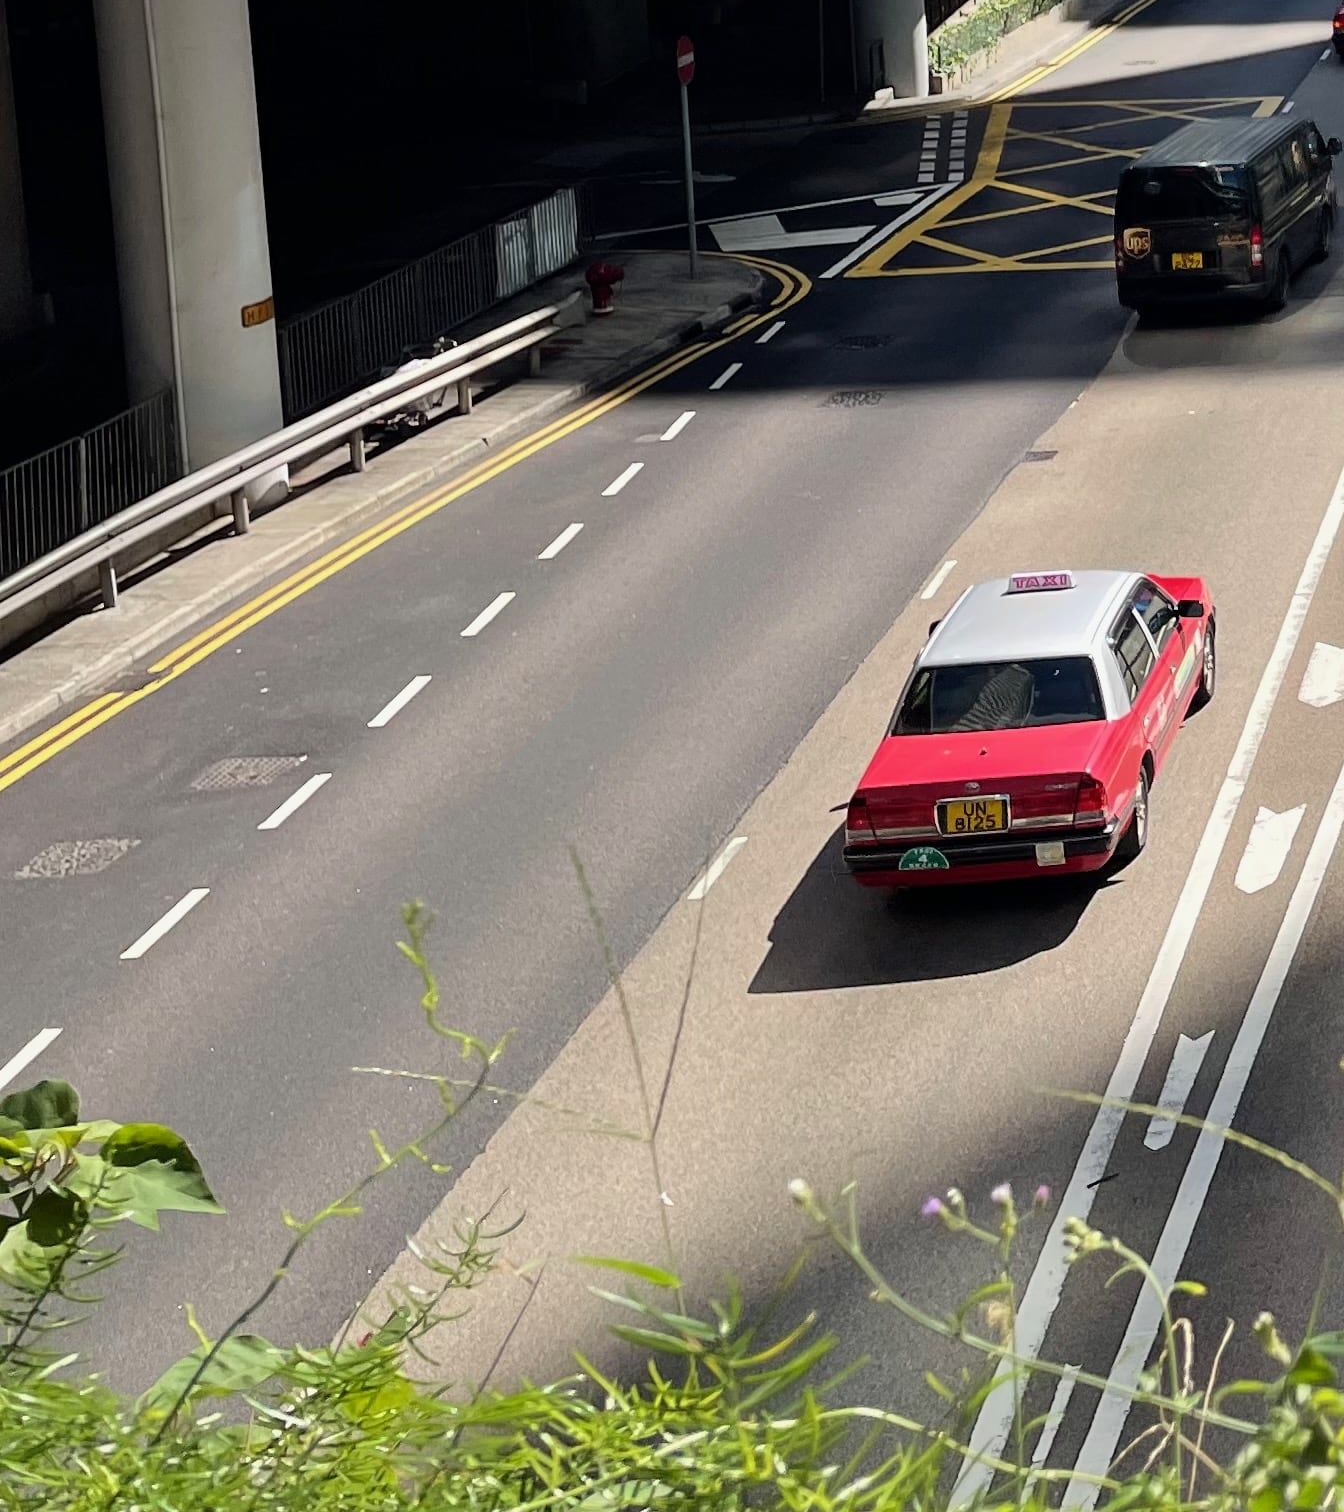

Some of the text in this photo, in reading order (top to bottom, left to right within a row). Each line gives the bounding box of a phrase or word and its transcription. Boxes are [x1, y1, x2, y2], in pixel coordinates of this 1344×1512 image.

[1126, 236, 1150, 255] ups
[1012, 573, 1069, 589] TAXI
[963, 803, 987, 817] UN
[955, 815, 997, 831] 8125
